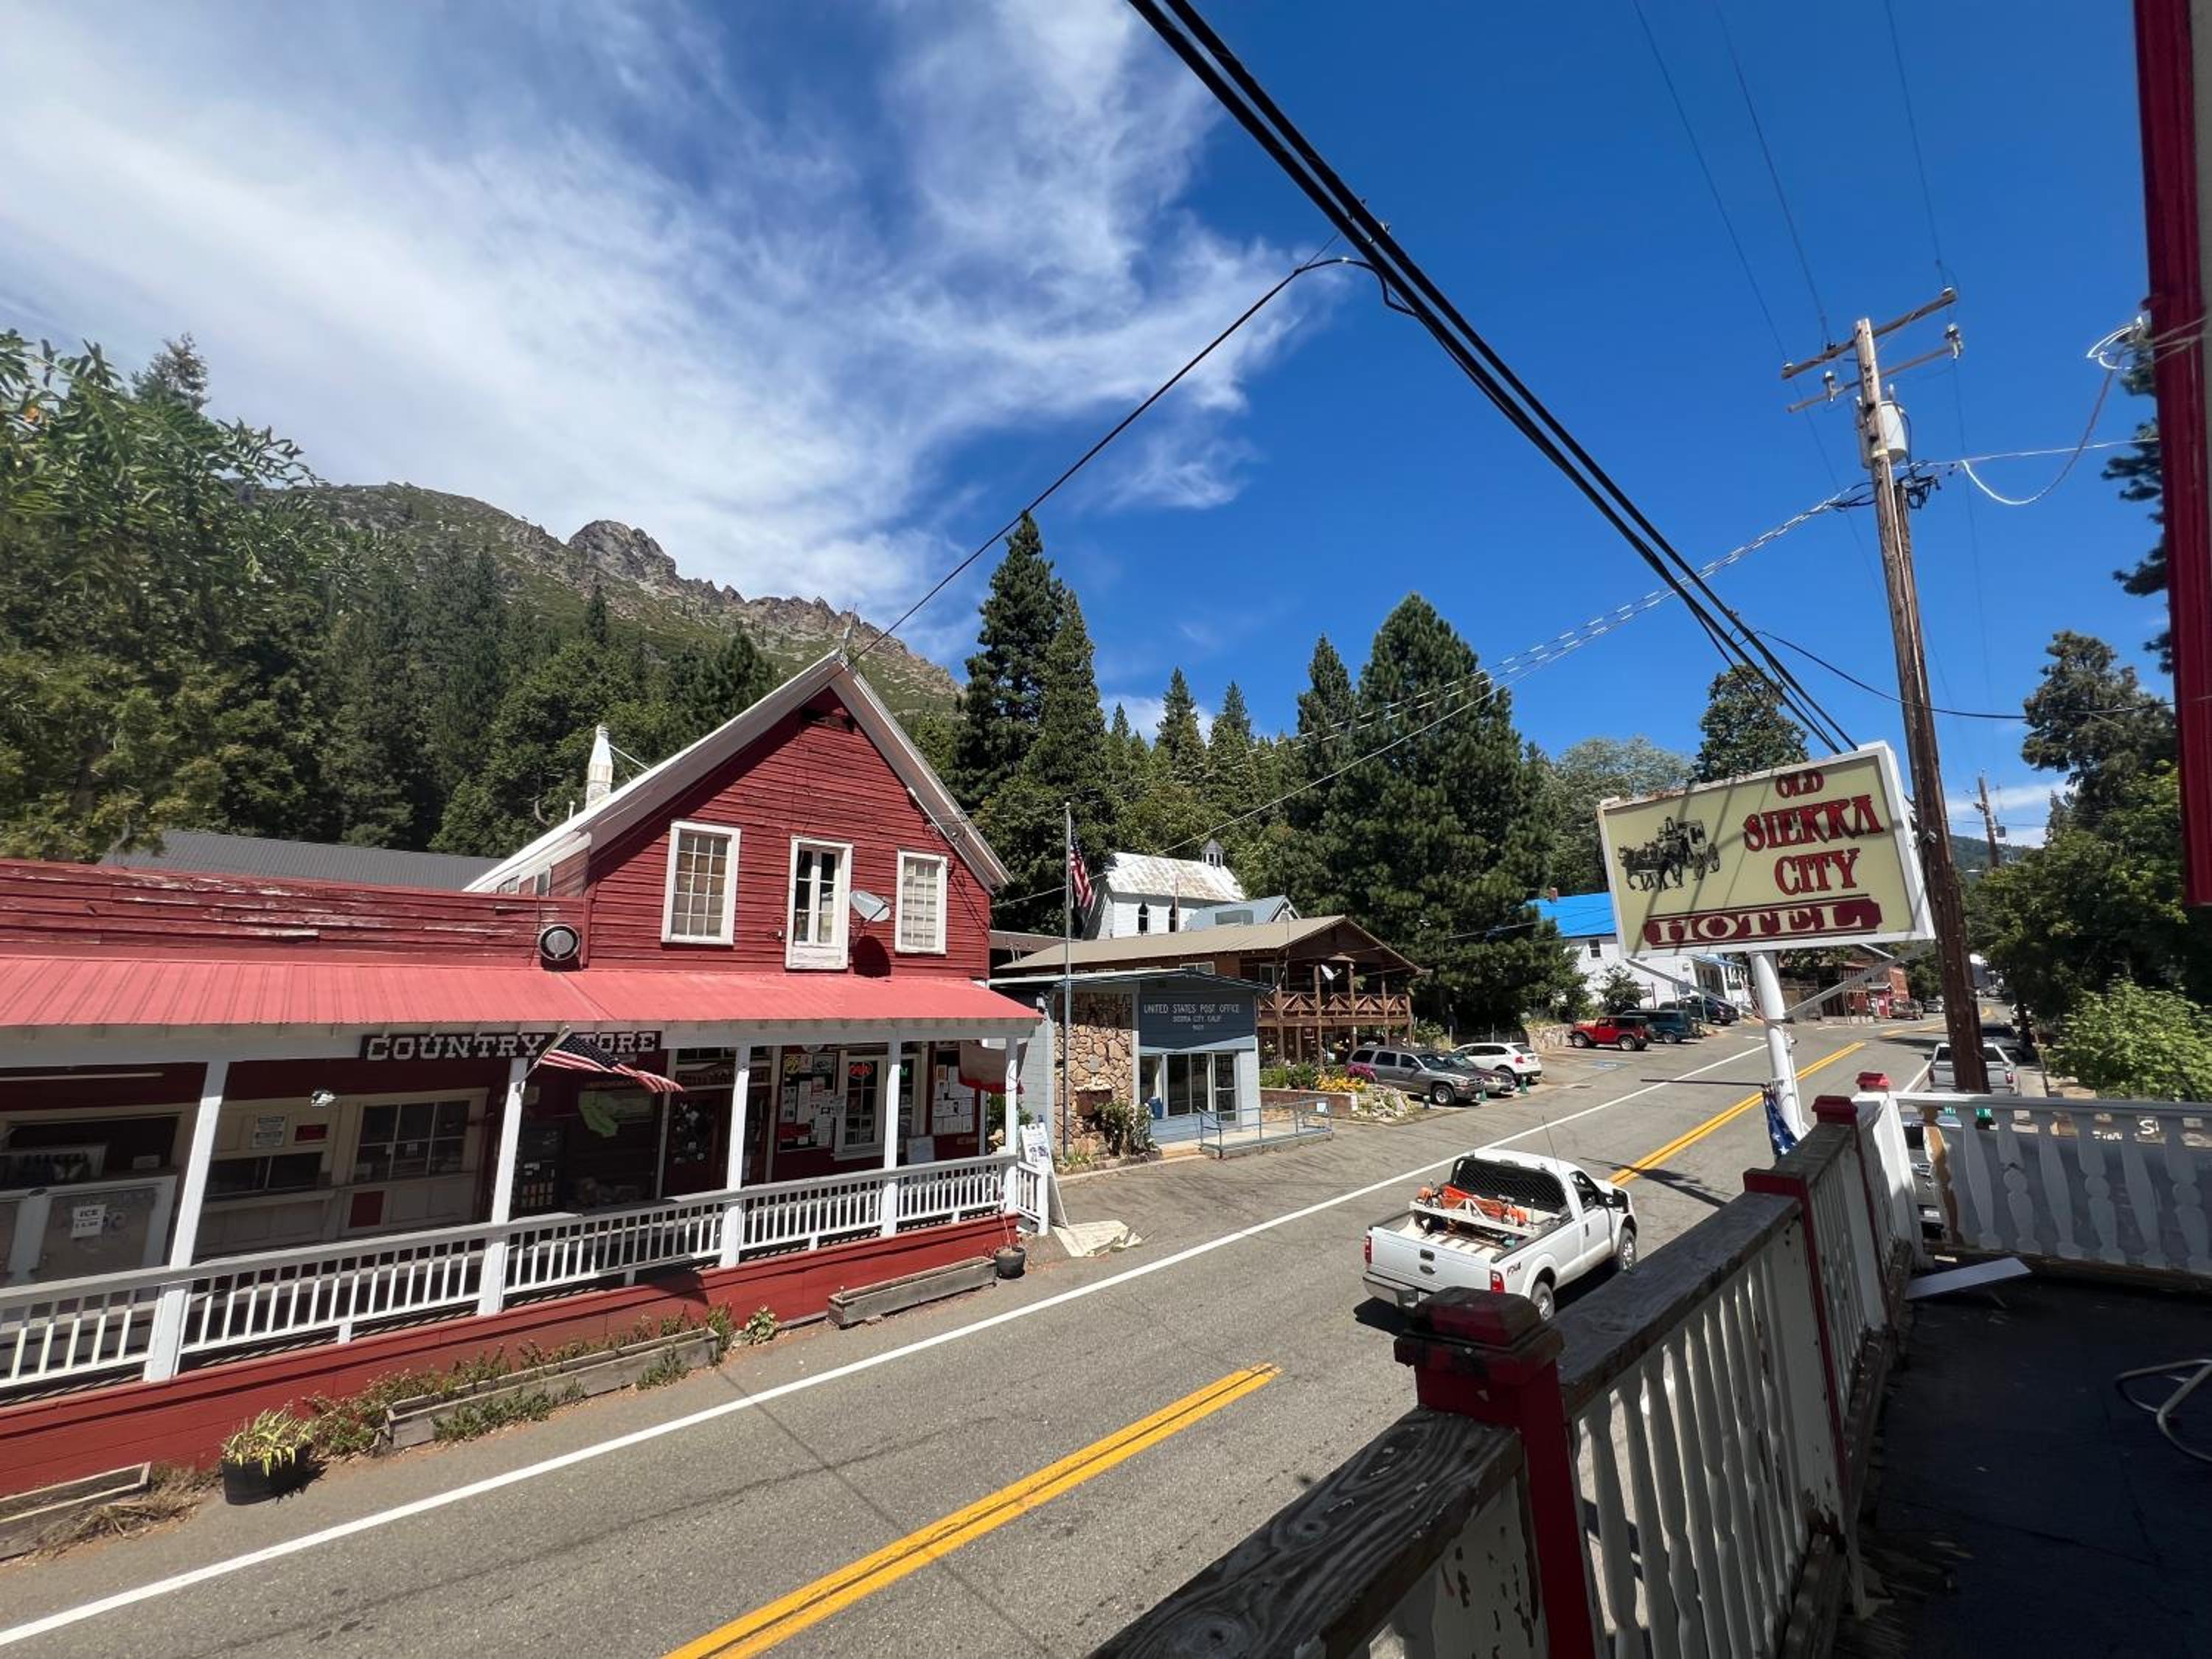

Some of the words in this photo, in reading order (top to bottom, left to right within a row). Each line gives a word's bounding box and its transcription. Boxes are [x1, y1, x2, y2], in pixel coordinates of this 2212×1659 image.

[1775, 768, 1824, 799] OLD
[1743, 794, 1884, 852] SIERRA
[1774, 847, 1860, 897] CITY
[1656, 905, 1863, 942] HOTEL
[1144, 1004, 1169, 1014] UNITED
[1173, 1004, 1195, 1014] STATES
[1200, 1004, 1216, 1014] POST
[1219, 1004, 1239, 1014] OFFICE
[367, 1032, 546, 1060] COUNTRY
[576, 1032, 655, 1053] TORE
